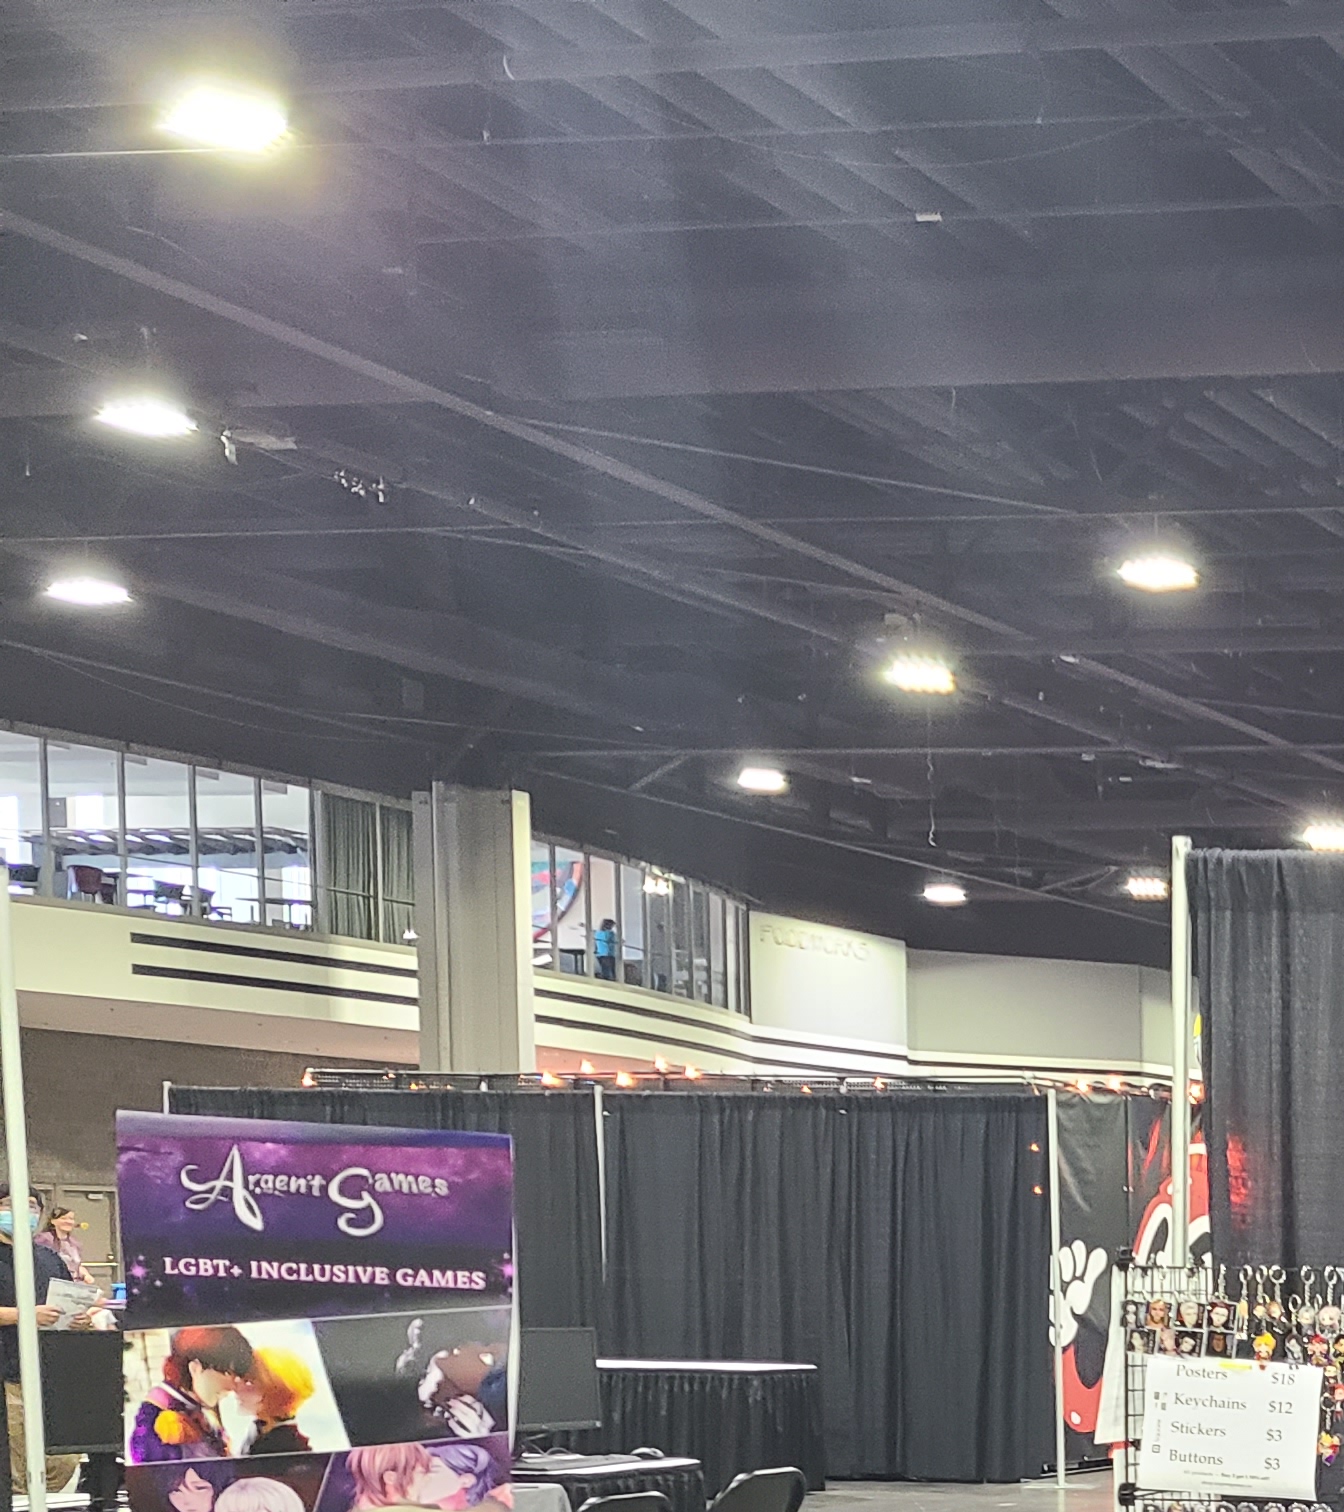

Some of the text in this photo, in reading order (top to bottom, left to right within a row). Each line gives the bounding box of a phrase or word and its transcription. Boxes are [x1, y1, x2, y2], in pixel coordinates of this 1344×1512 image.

[180, 1144, 450, 1237] Argent Games
[163, 1256, 488, 1291] LGBT+ INCLUSIVE GAMES
[1176, 1363, 1296, 1386] Posters $18
[1173, 1392, 1294, 1416] Keychains $12
[1170, 1420, 1227, 1438] Stickers
[1266, 1429, 1284, 1443] $3
[1169, 1449, 1281, 1471] Buttons $3
